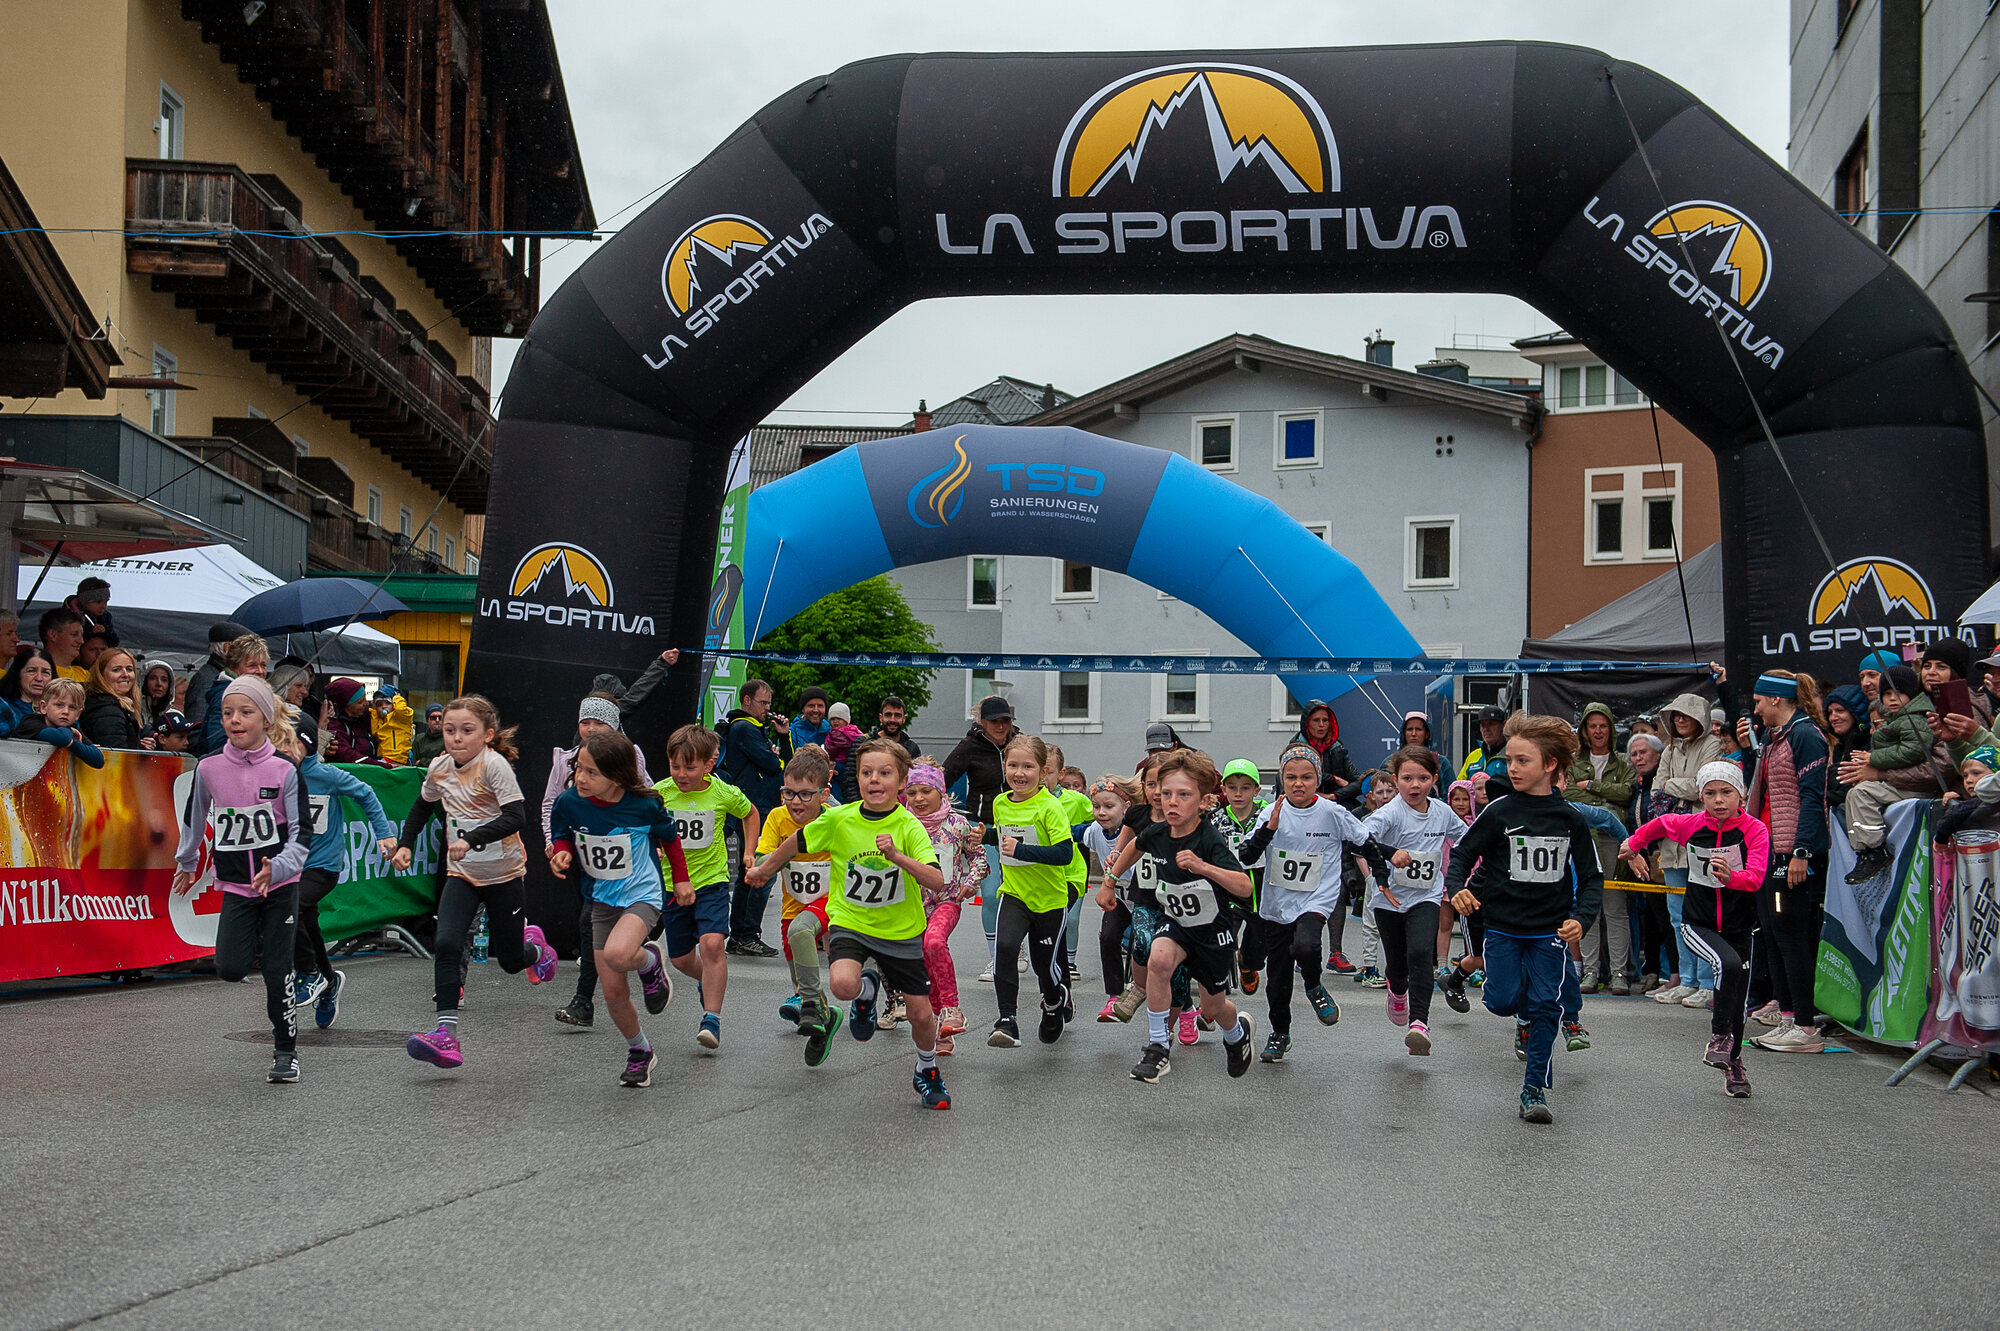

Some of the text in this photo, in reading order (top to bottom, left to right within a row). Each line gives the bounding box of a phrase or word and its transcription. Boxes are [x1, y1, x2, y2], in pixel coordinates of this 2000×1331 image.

[936, 205, 1467, 255] LA SPORTIVA
[642, 213, 835, 370] LA SPORTIVA
[1583, 196, 1784, 370] LA SPORTIVA
[986, 463, 1106, 497] TSD
[990, 497, 1099, 514] SANIERUNGEN
[1029, 511, 1097, 523] WASSERSCHÄDEN
[480, 597, 655, 636] LA SPORTIVA
[1763, 632, 1800, 655] LA
[217, 809, 275, 847] 220
[675, 819, 704, 841] 98
[580, 843, 626, 870] 182
[1141, 858, 1152, 880] 5
[1517, 846, 1560, 872] 101
[790, 871, 821, 894] 88
[1282, 859, 1312, 882] 97
[1406, 860, 1435, 881] 83
[846, 869, 900, 904] 227
[0, 879, 154, 927] Willkommen
[1166, 893, 1201, 918] 89
[1217, 929, 1234, 946] DA
[1965, 876, 1995, 977] SILBER
[282, 970, 297, 1038] adidas
